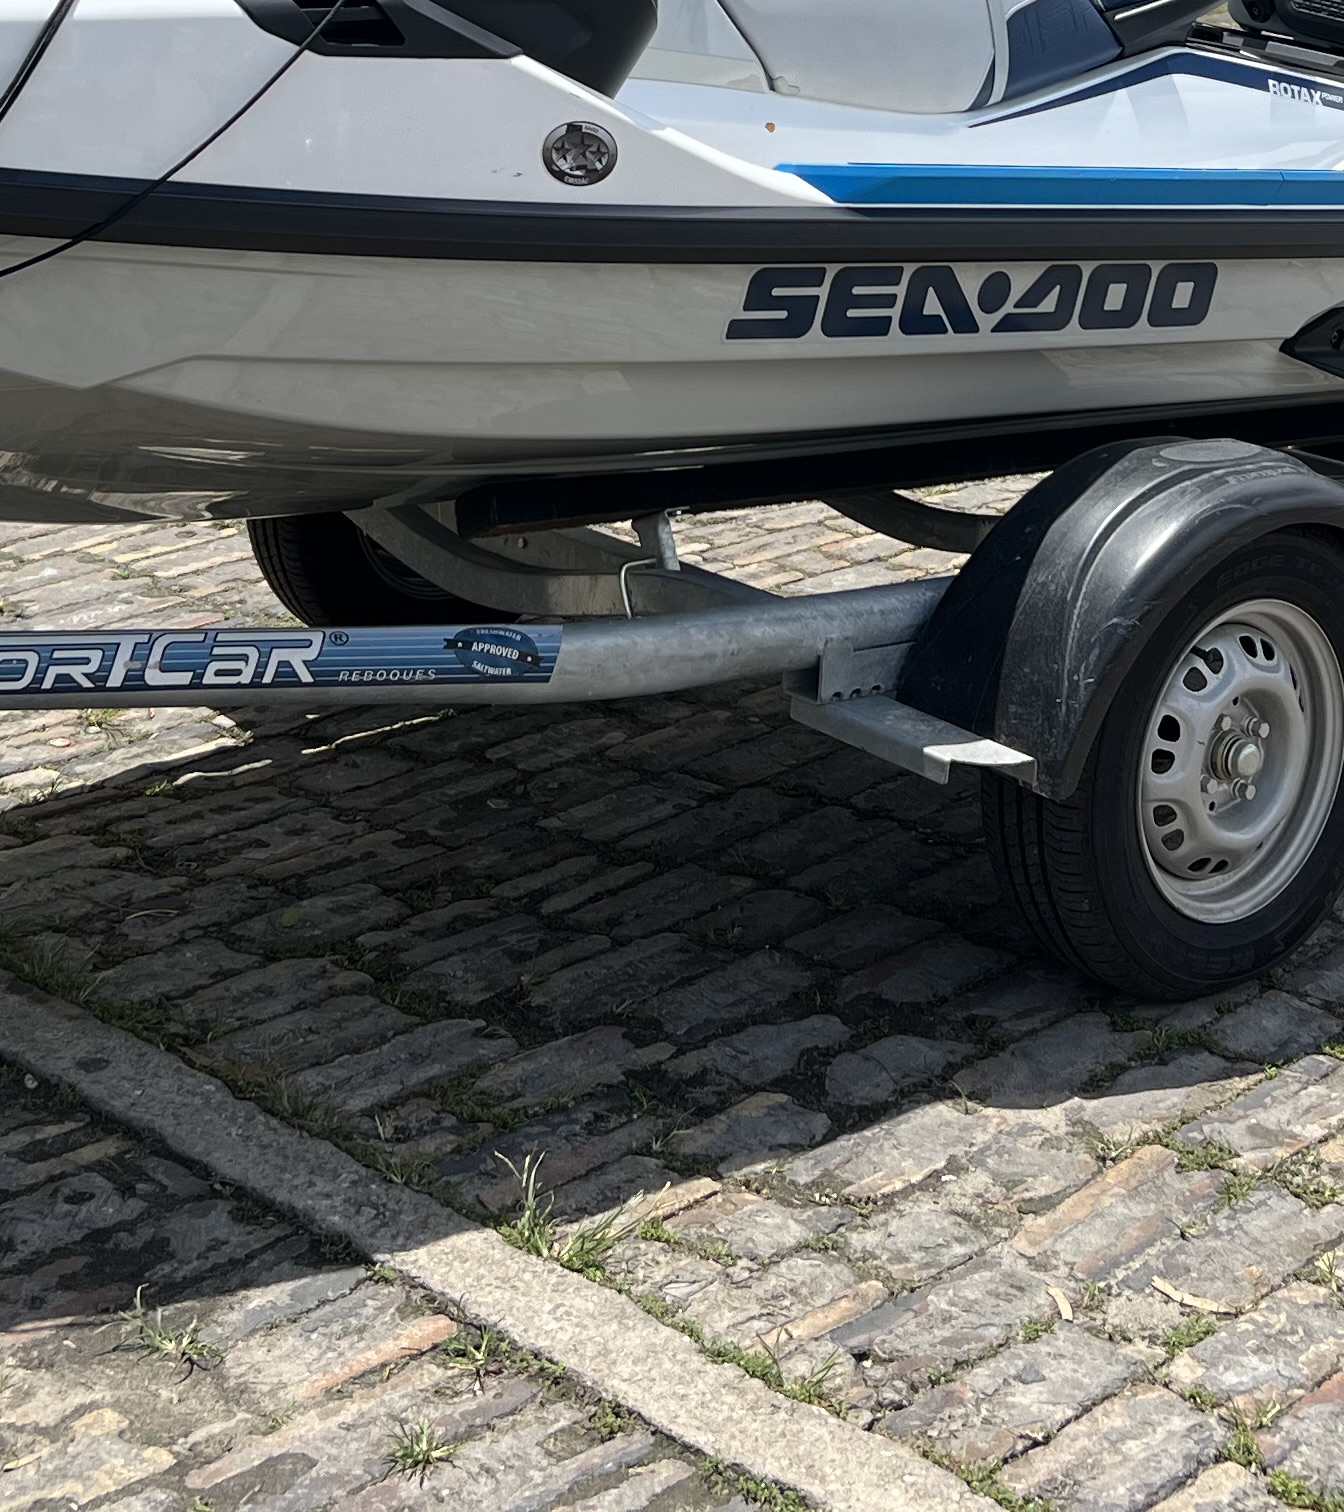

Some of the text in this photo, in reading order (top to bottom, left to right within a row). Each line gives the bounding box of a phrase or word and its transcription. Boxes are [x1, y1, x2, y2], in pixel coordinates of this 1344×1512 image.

[1267, 78, 1344, 107] ROTAX POWER
[471, 641, 520, 660] APPROVED
[338, 668, 437, 682] REBOQUES
[471, 660, 512, 676] SALTWATER
